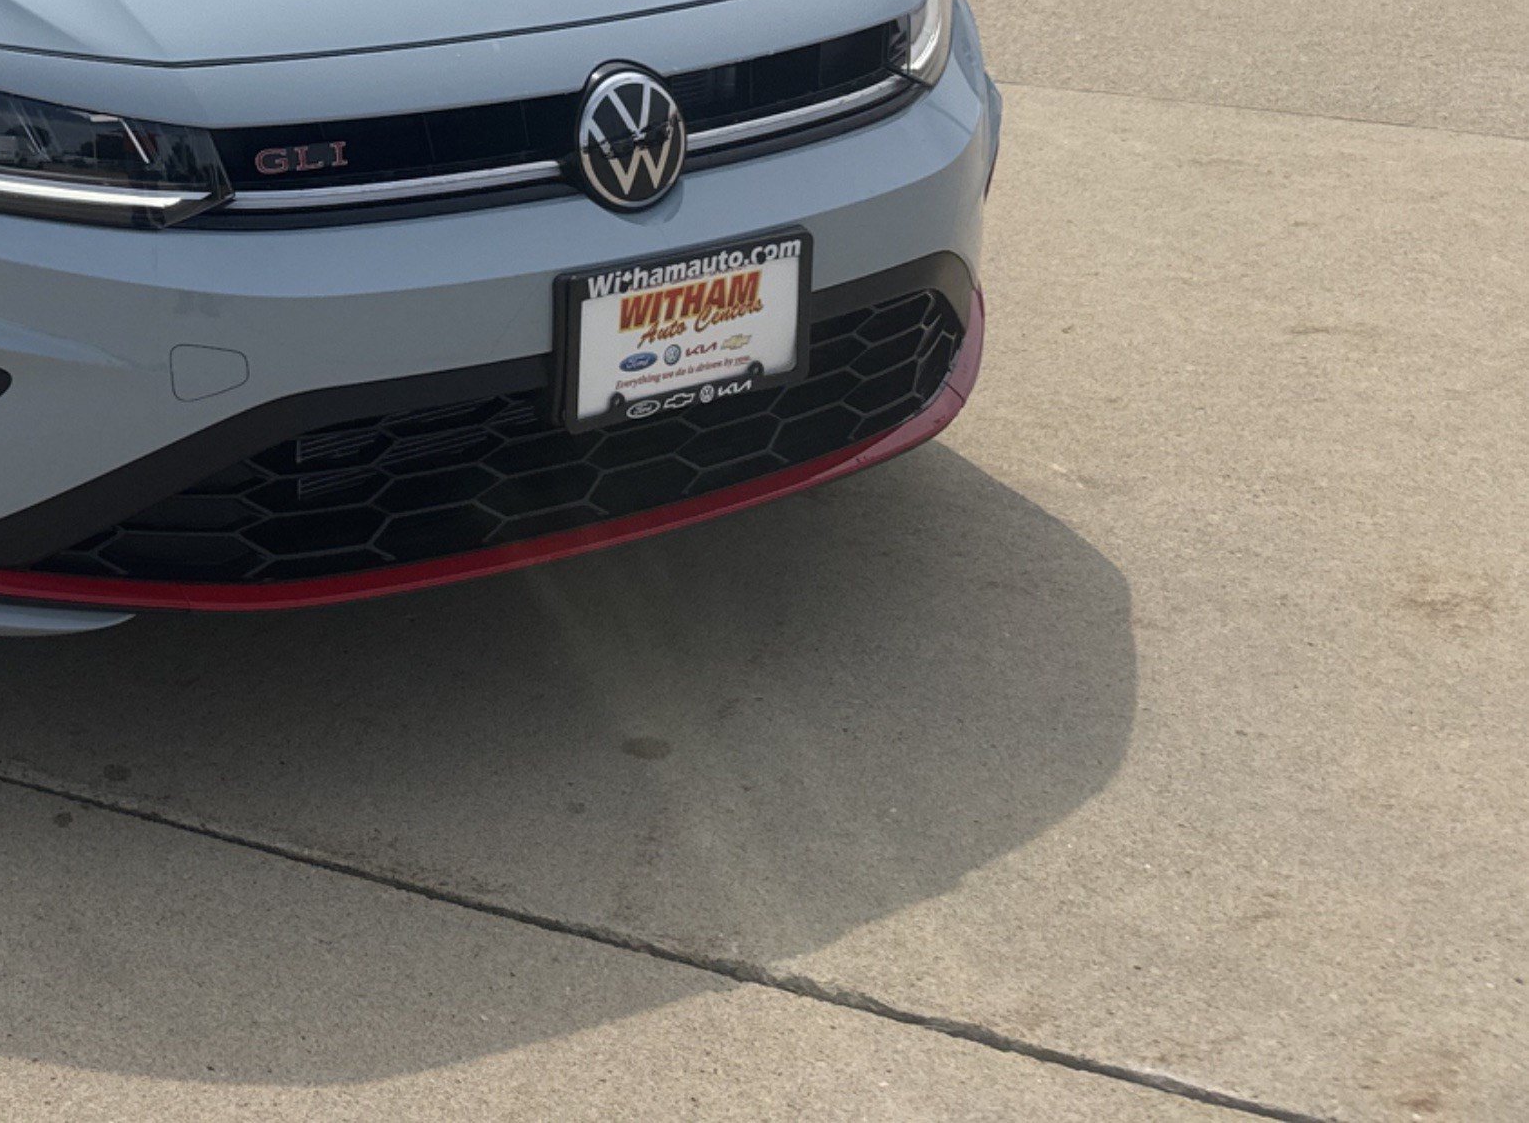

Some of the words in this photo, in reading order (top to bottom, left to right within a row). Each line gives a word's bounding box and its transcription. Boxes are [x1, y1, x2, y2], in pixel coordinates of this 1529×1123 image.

[254, 141, 349, 175] GLI
[580, 73, 683, 205] VW
[619, 270, 762, 333] WITHAM
[637, 319, 687, 349] Auto
